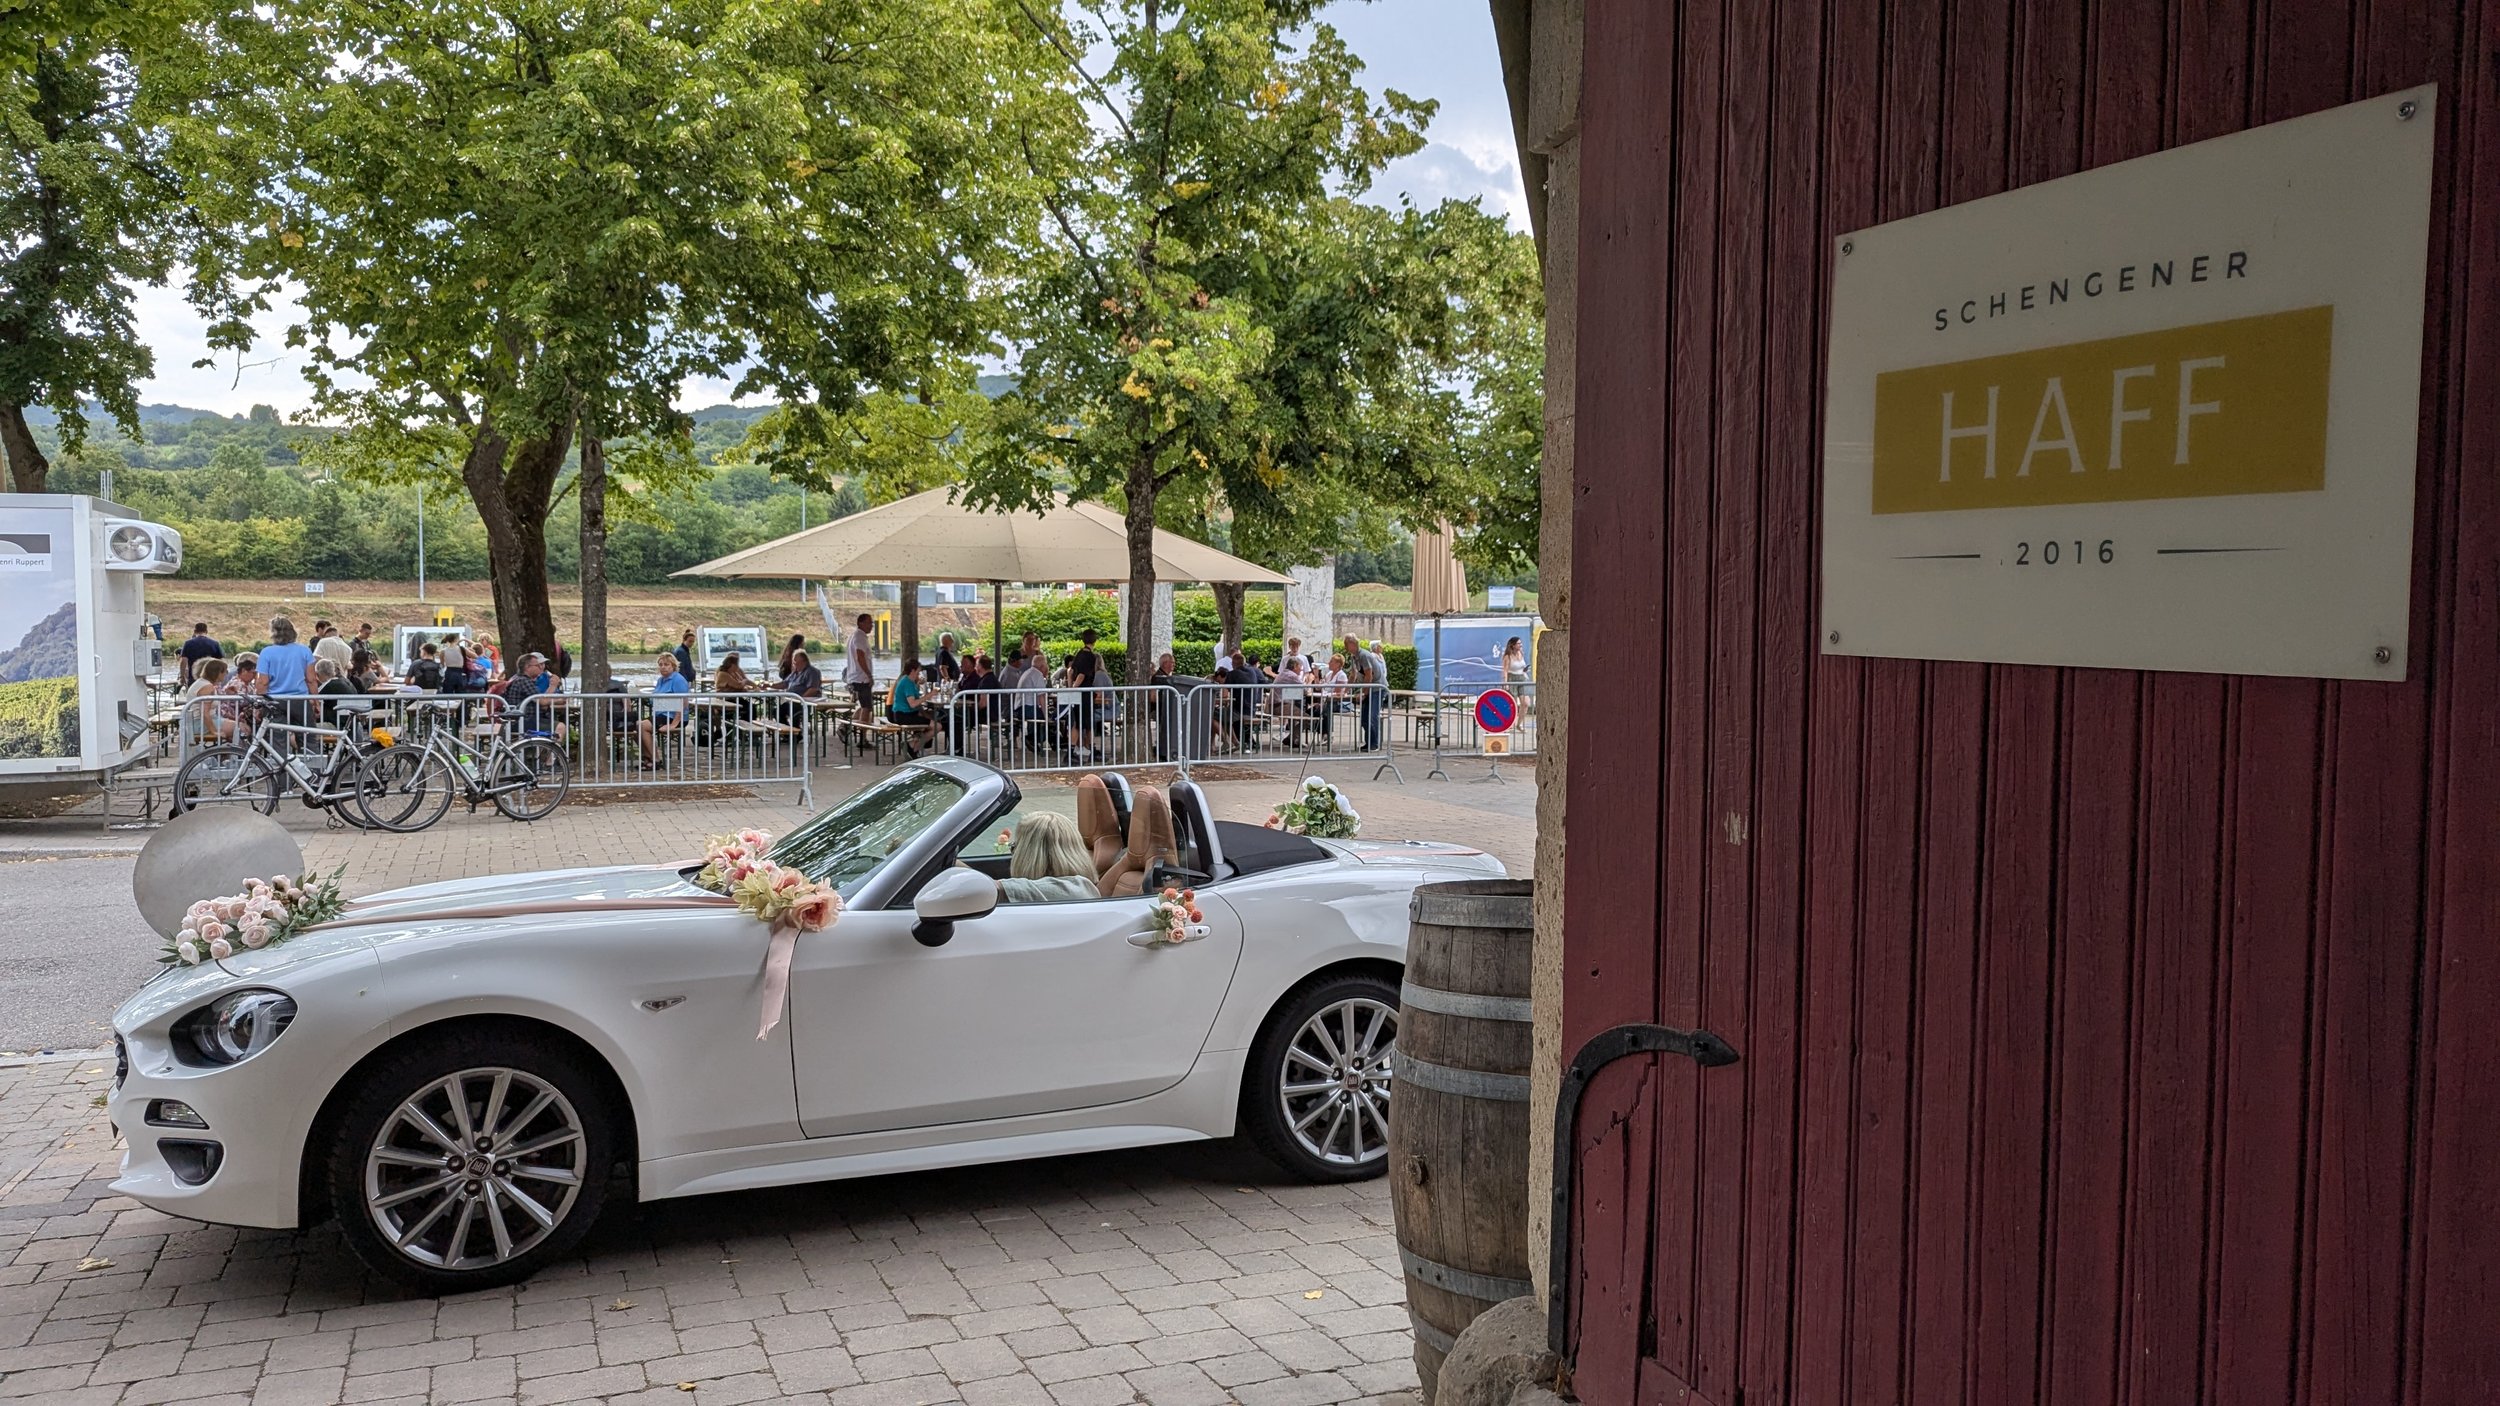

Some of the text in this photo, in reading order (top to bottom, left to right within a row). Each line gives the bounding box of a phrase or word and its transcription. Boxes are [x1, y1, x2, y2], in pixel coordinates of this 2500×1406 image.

[1935, 251, 2248, 331] SCHENGENER
[1939, 355, 2226, 482] HAFF
[15, 558, 44, 567] Ruppert
[2016, 539, 2115, 565] 2016
